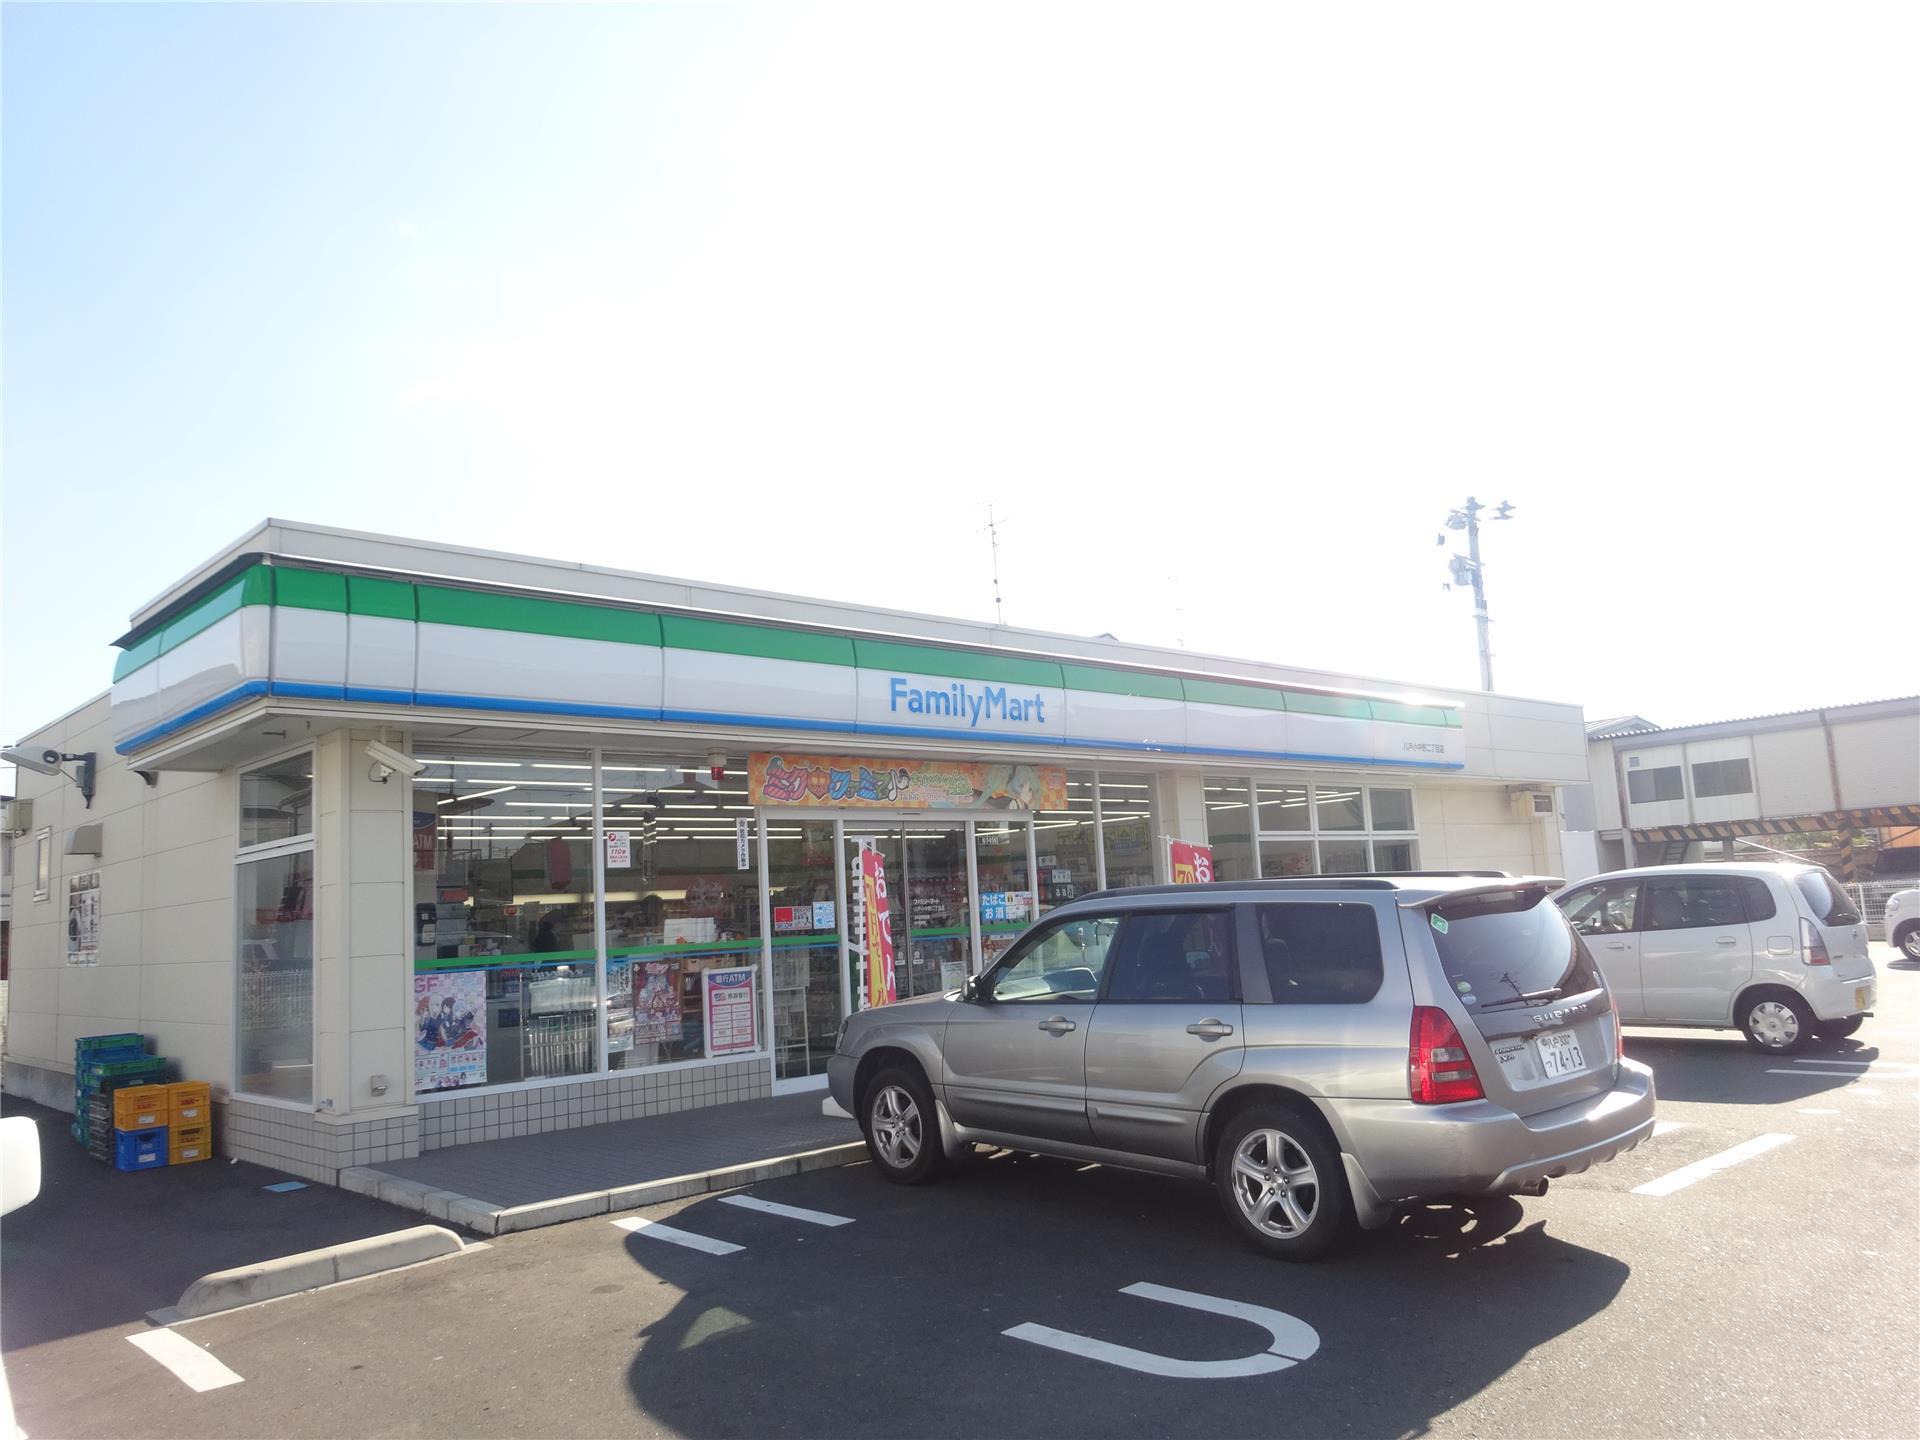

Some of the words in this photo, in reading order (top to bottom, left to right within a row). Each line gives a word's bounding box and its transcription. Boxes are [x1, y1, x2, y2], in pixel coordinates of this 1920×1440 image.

[890, 677, 1045, 727] FamilyMart
[1193, 852, 1210, 883] お
[982, 894, 1005, 906] たばこ
